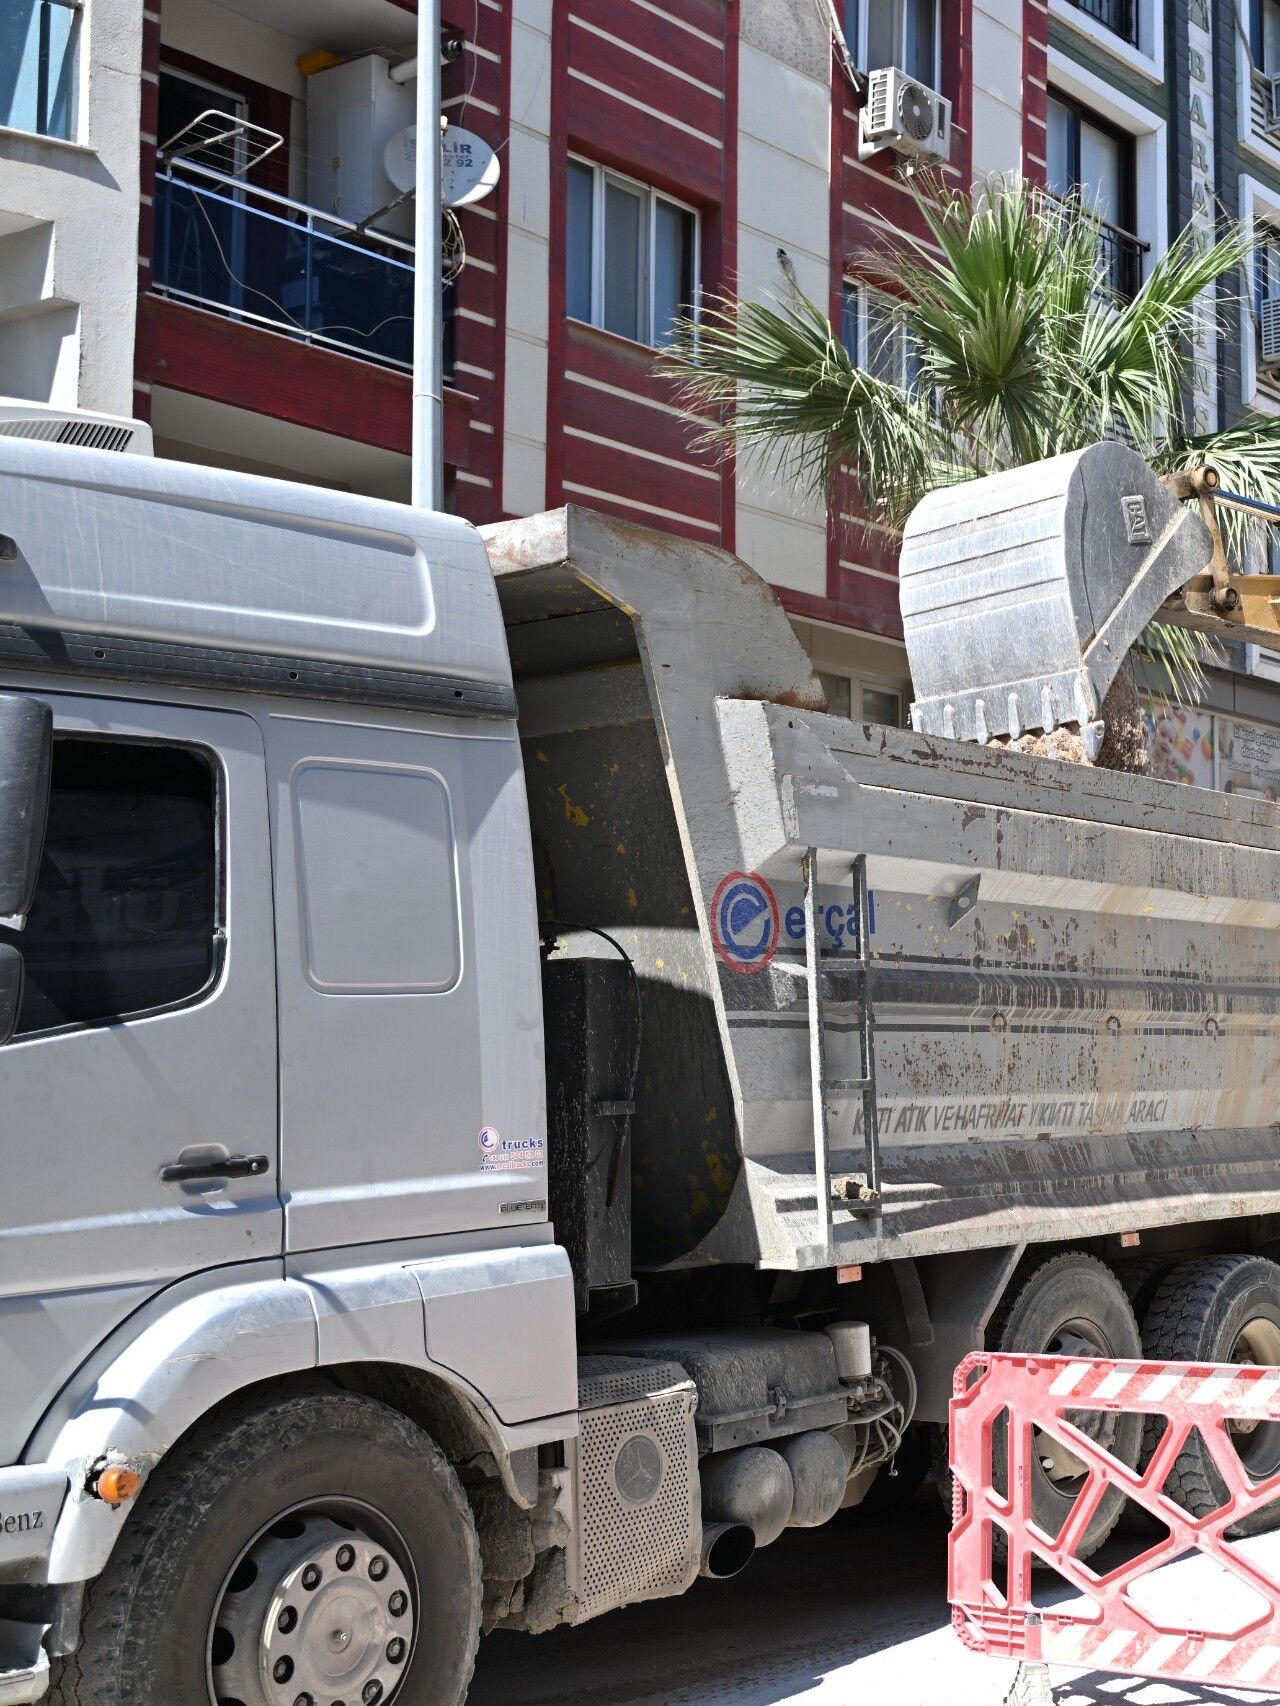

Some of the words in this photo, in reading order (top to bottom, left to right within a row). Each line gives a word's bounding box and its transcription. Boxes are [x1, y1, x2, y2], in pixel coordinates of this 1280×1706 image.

[442, 142, 472, 154] LİR
[1127, 502, 1146, 535] CAT
[784, 889, 876, 950] eçal
[853, 1107, 894, 1136] KTI
[894, 1105, 932, 1134] ATIK
[1128, 1099, 1168, 1123] ARACI
[502, 1137, 544, 1150] trucks
[0, 1511, 43, 1533] enz
